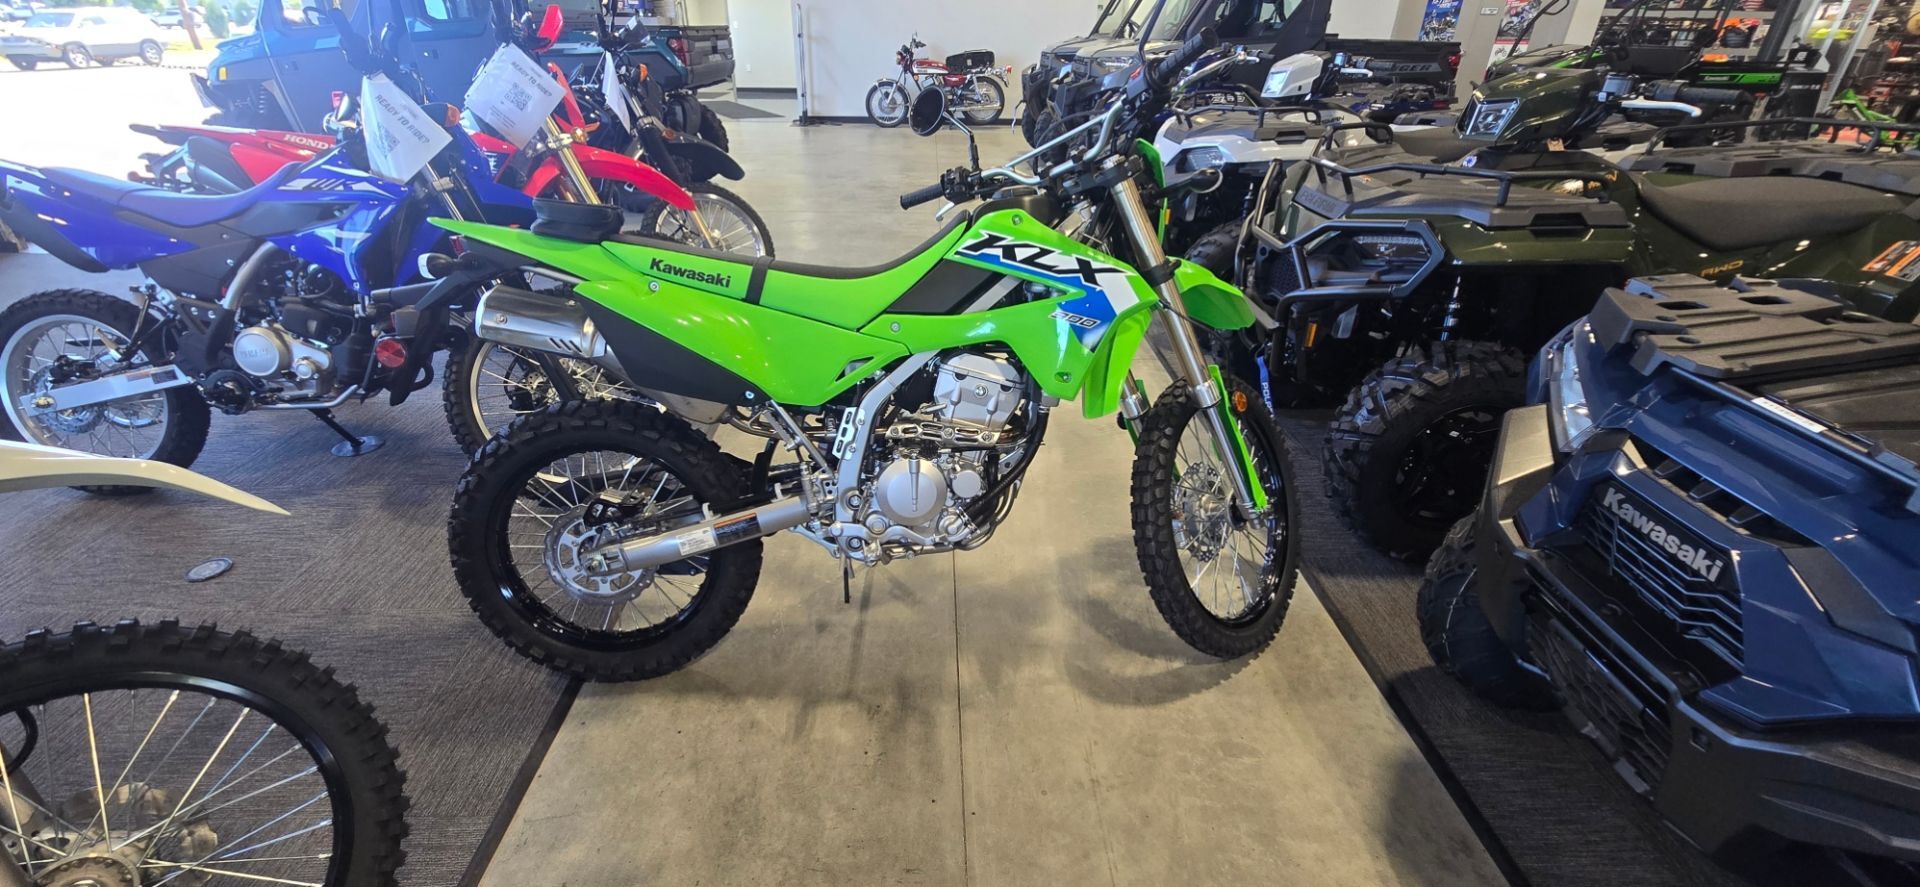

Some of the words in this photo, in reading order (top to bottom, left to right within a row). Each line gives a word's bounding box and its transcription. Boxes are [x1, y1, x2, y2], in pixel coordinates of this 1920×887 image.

[375, 94, 400, 117] READY
[397, 115, 410, 126] TO
[649, 257, 732, 289] Kawasaki
[958, 231, 1130, 289] KLX
[1602, 487, 1724, 582] Kawasaki
